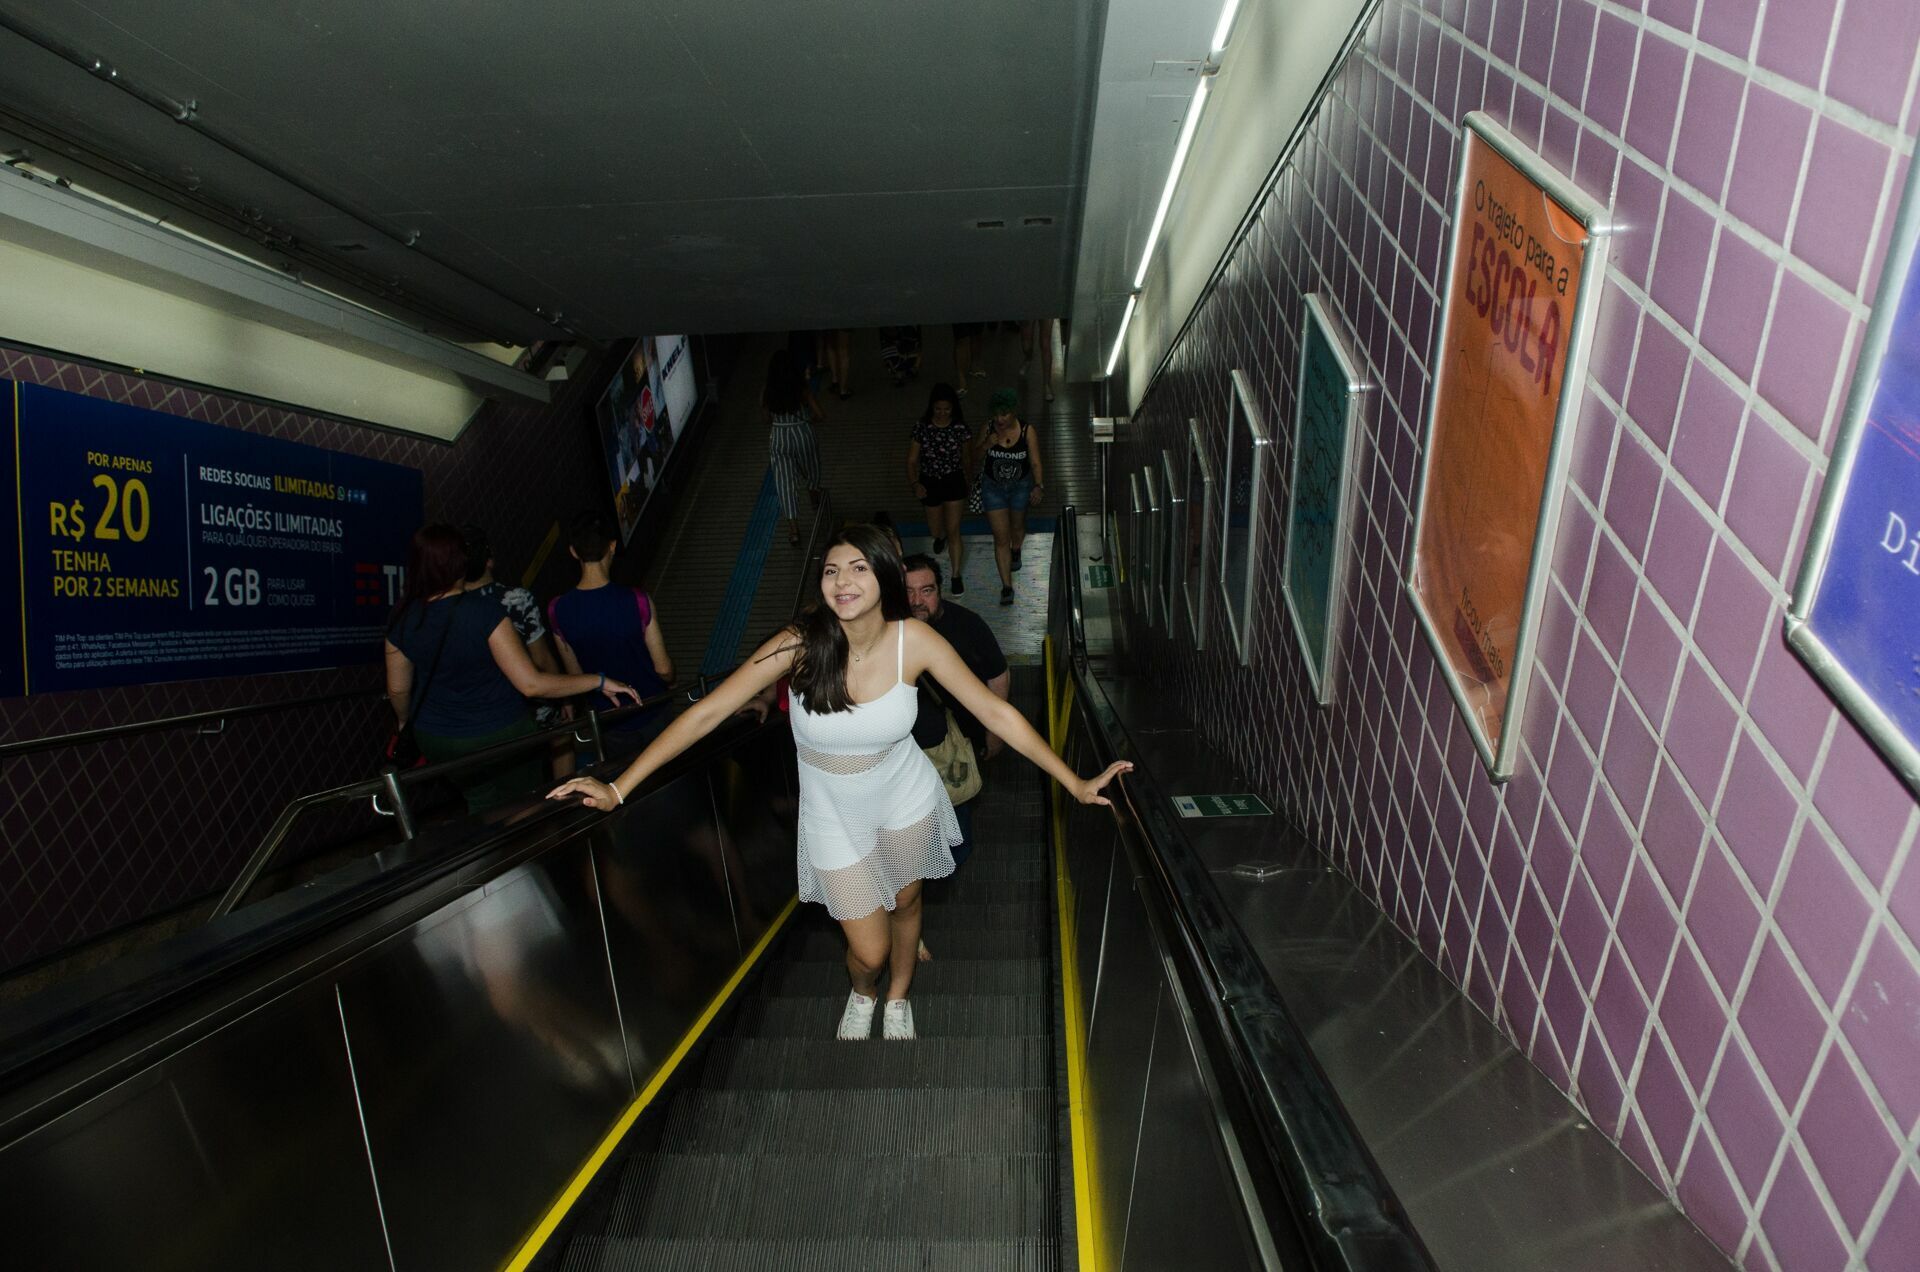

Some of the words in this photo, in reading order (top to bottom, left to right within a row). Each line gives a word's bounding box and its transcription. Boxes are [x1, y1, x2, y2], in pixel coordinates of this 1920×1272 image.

[1475, 180, 1485, 211] O
[1488, 192, 1523, 249] trajeto
[1525, 236, 1555, 283] para
[1557, 267, 1569, 296] a
[1465, 221, 1560, 396] ESCOLA
[87, 451, 110, 468] POR
[111, 455, 153, 474] APENAS
[199, 465, 233, 485] REDES
[234, 471, 271, 491] SOCIAIS
[274, 474, 336, 500] ILIMITADAS
[49, 499, 87, 543] R$
[92, 473, 151, 543] 20
[201, 503, 272, 534] LIGAÇÕES
[275, 512, 343, 538] ILIMITADAS
[202, 530, 224, 545] PARA
[225, 532, 267, 548] QUALQUER
[268, 536, 310, 551] OPERADORA
[311, 539, 321, 552] DO
[51, 549, 112, 573] TENHA
[53, 575, 90, 598] POR
[92, 576, 103, 598] 2
[106, 577, 181, 598] SEMANAS
[203, 566, 219, 606] 2
[224, 567, 262, 606] GB
[267, 577, 286, 590] PARA
[287, 577, 305, 590] USAR
[267, 593, 289, 607] COMO
[382, 564, 405, 606] TI
[1461, 586, 1482, 635] ficou
[1482, 629, 1504, 679] mais
